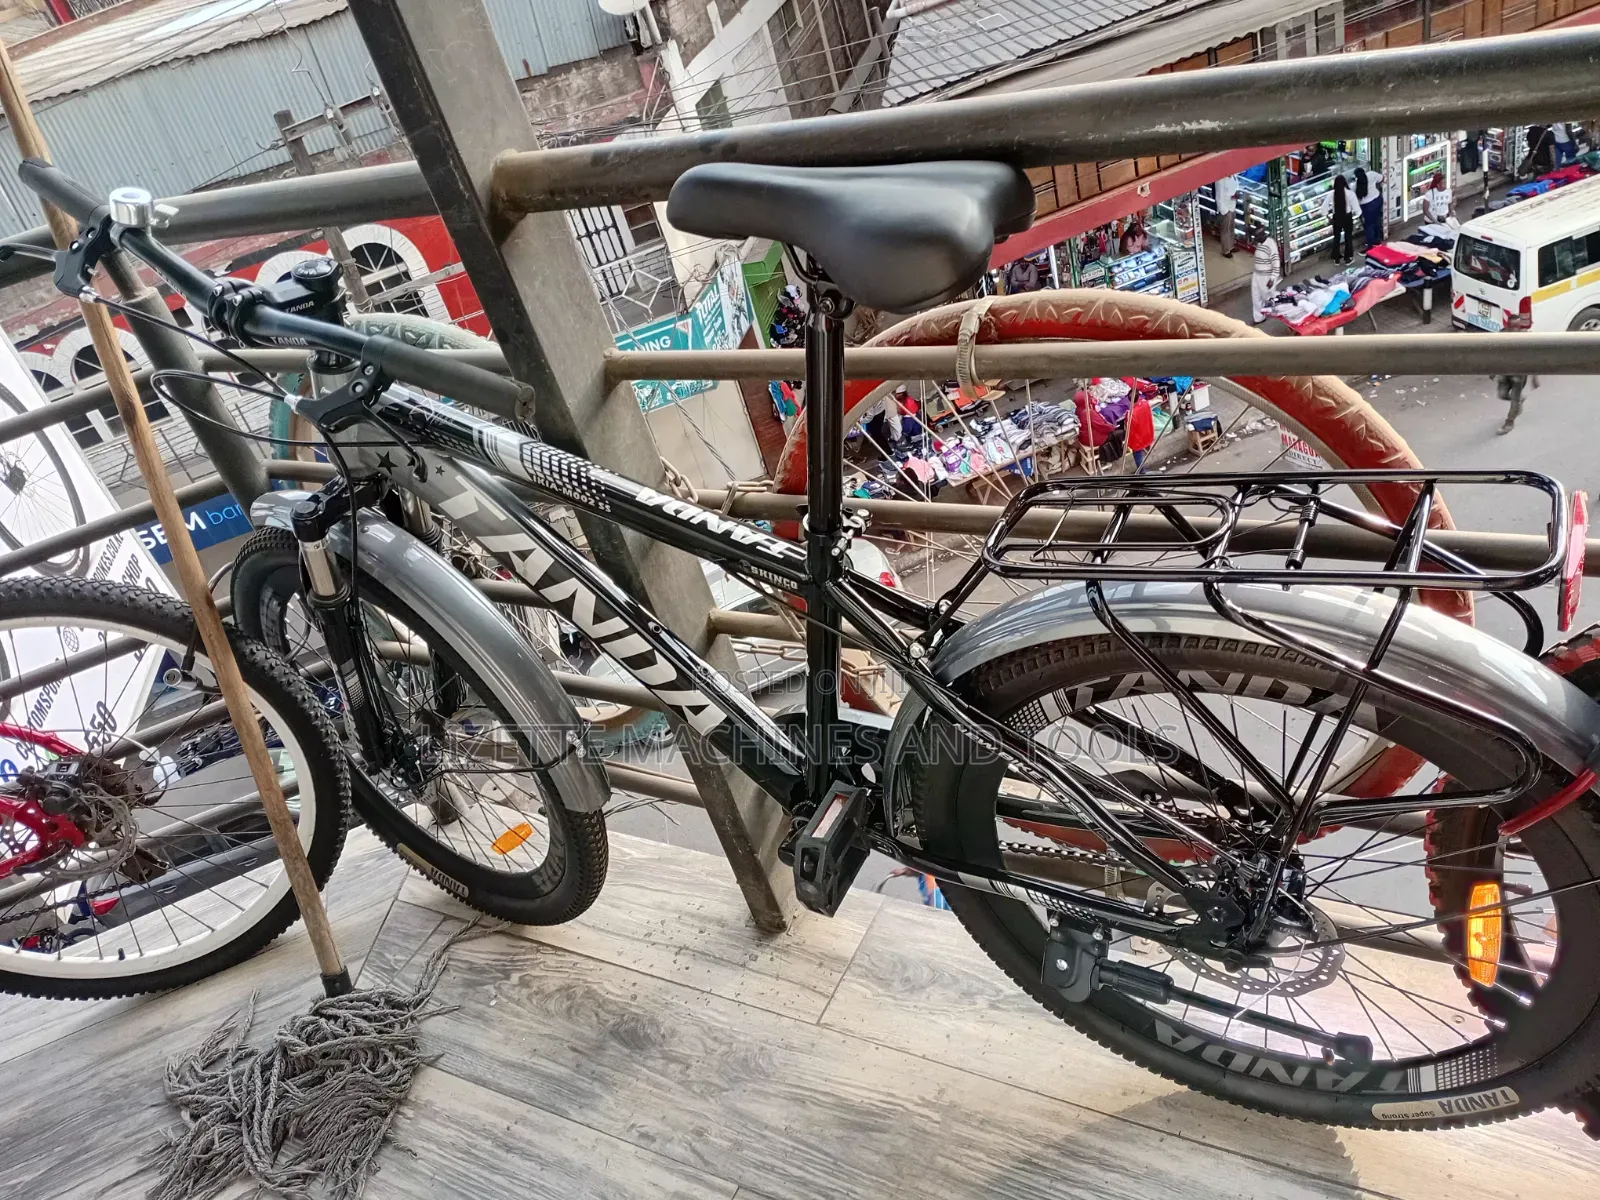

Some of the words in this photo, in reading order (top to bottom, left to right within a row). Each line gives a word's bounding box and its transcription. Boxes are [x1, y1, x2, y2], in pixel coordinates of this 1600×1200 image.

[285, 300, 315, 315] TANDA
[269, 336, 309, 346] TANDA
[205, 503, 243, 526] ba
[438, 475, 727, 737] TANDA
[1065, 668, 1381, 733] TANDA
[430, 866, 467, 897] TANDA
[1154, 1018, 1409, 1094] TANDA
[1411, 1110, 1436, 1119] Super
[1437, 1089, 1516, 1115] TANDA
